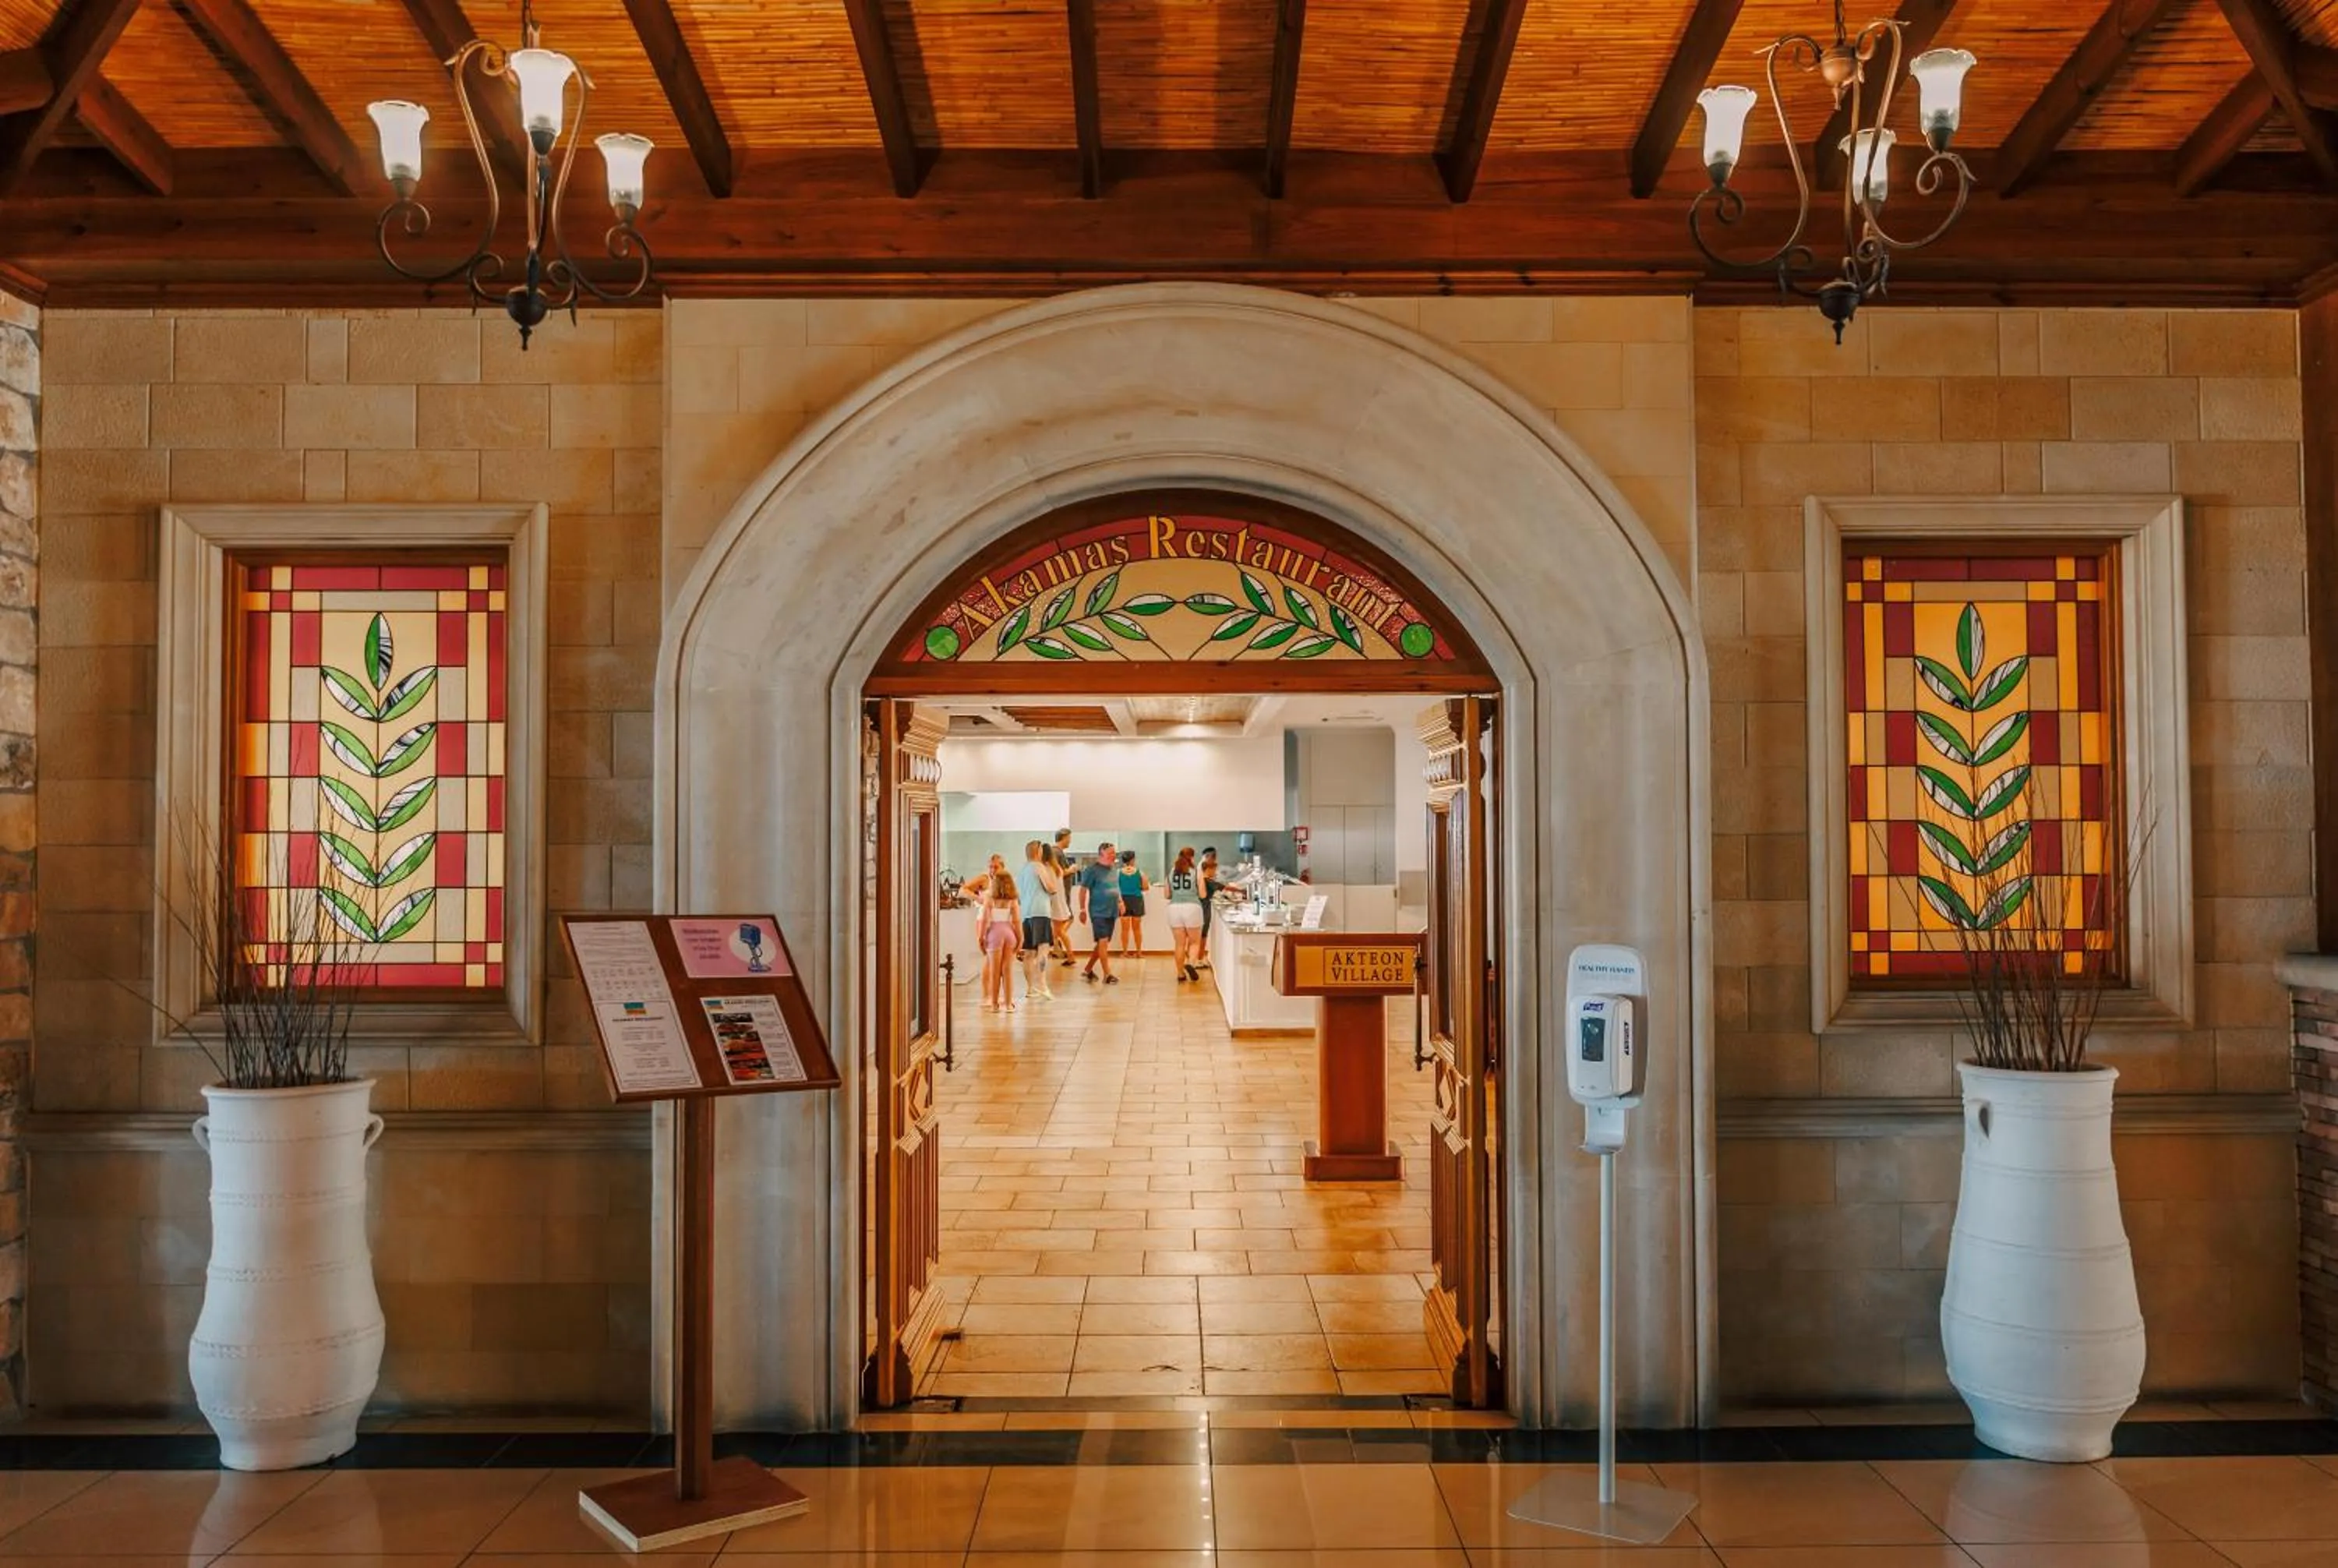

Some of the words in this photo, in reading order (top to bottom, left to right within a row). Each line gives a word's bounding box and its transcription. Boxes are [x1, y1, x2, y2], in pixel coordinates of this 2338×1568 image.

[959, 535, 1130, 641] Akamas
[1148, 515, 1400, 630] Restaurant
[1172, 872, 1192, 890] 96
[1332, 952, 1404, 966] AKTEON
[1331, 967, 1404, 981] VILLAGE
